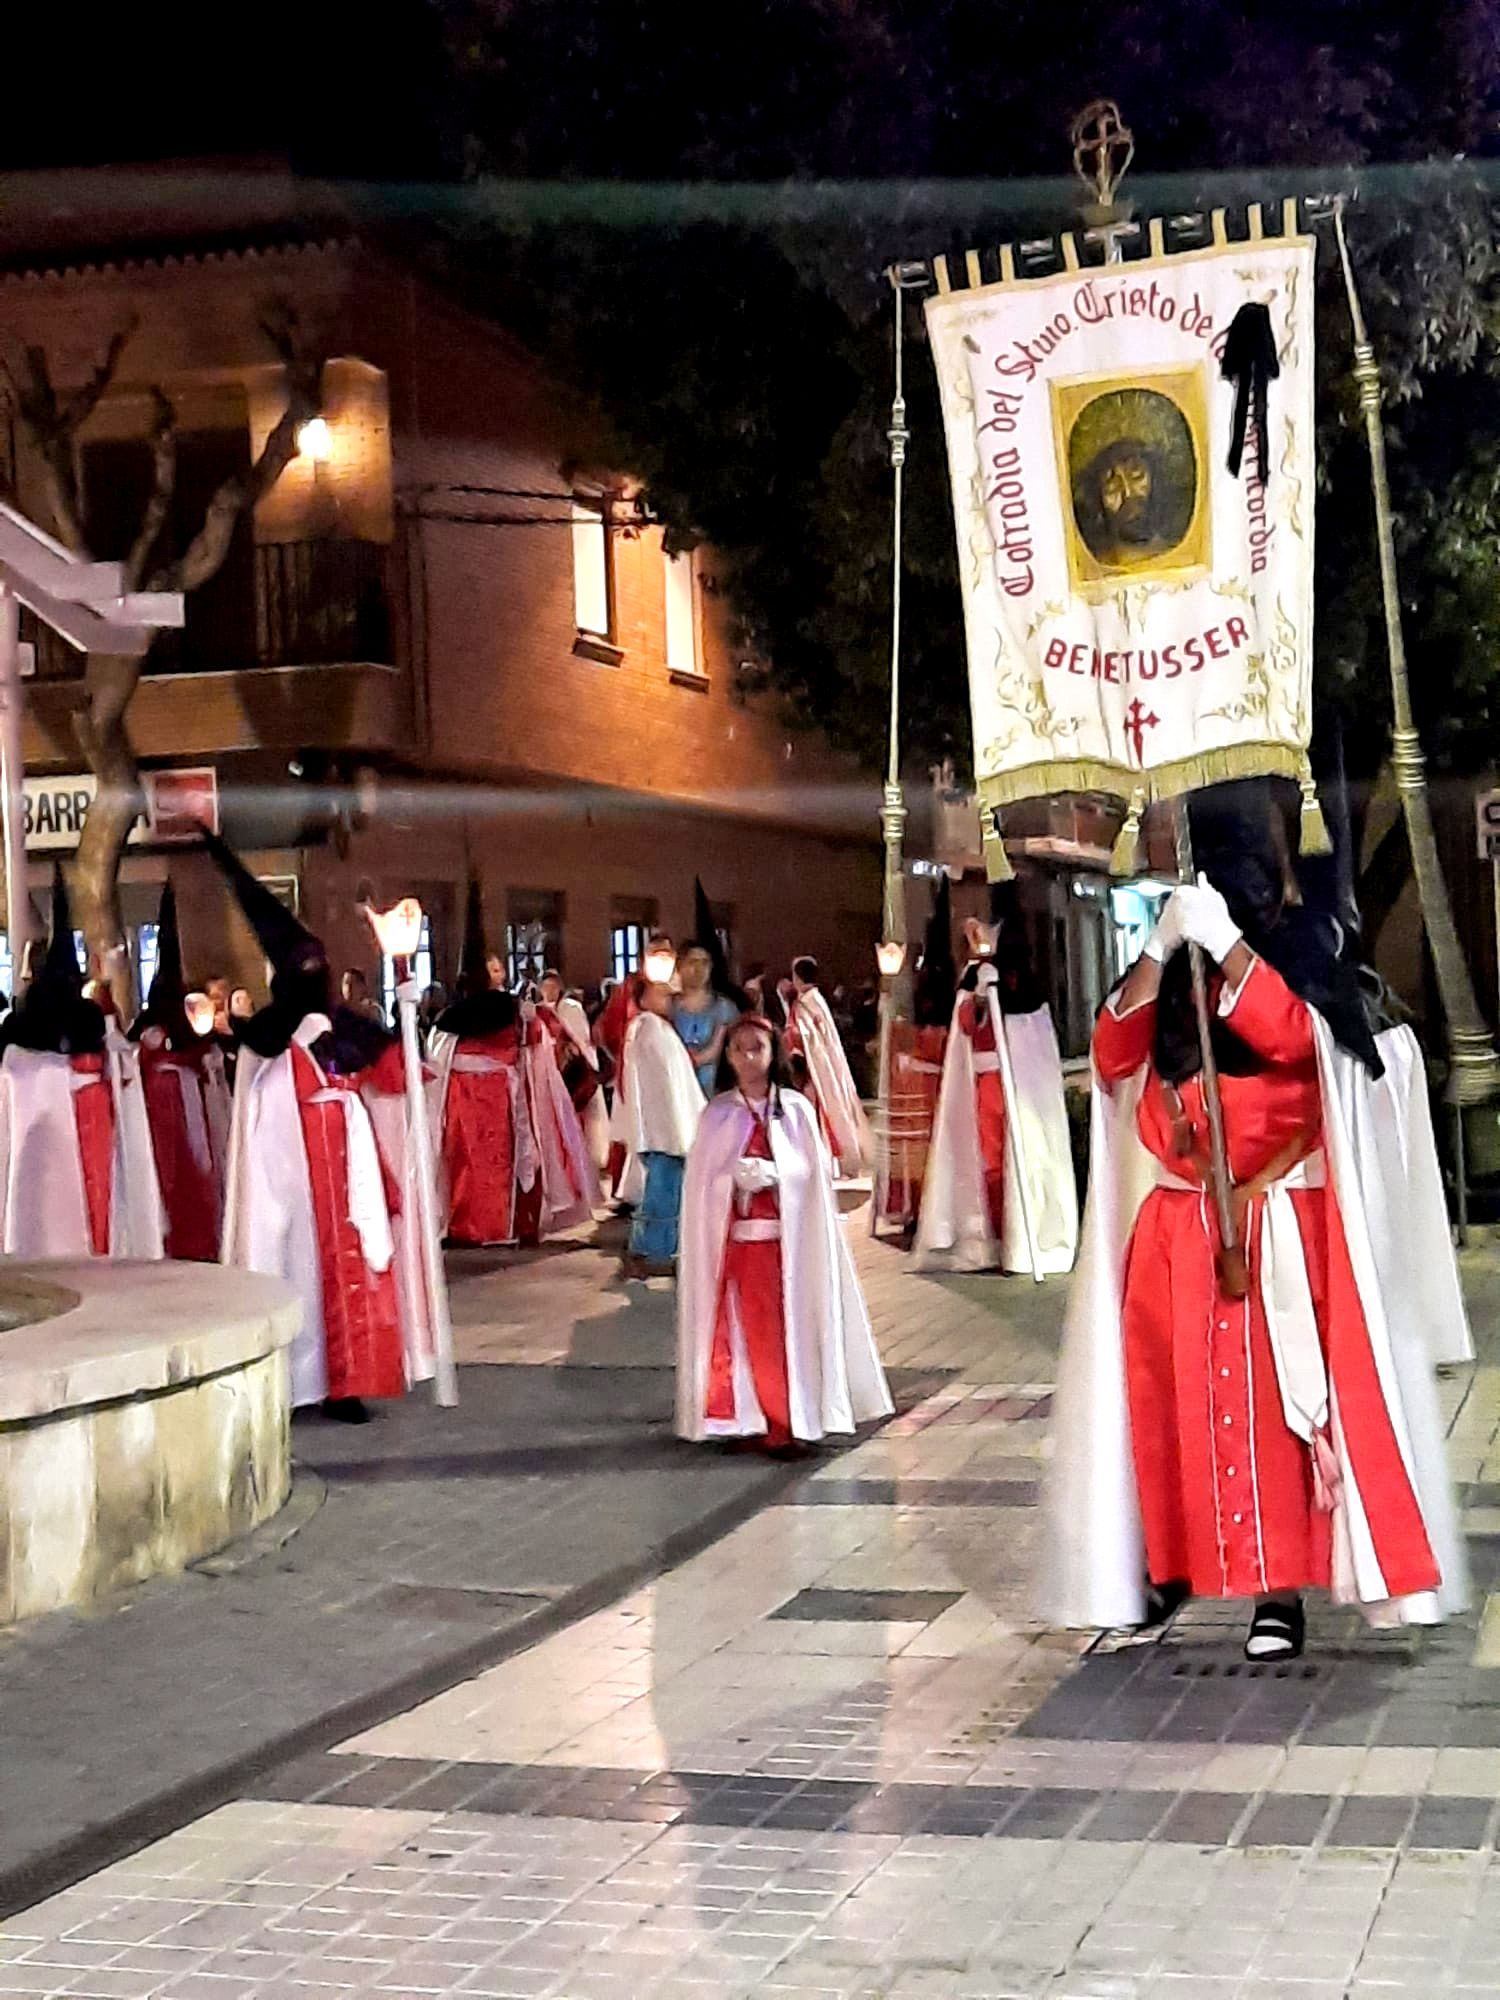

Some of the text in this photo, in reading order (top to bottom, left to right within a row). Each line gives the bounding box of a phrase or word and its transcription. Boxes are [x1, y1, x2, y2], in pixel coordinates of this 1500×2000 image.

[977, 389, 1025, 437] del
[1074, 279, 1175, 324] Cristo
[1179, 292, 1213, 338] de
[1044, 616, 1250, 685] BENETUSSER
